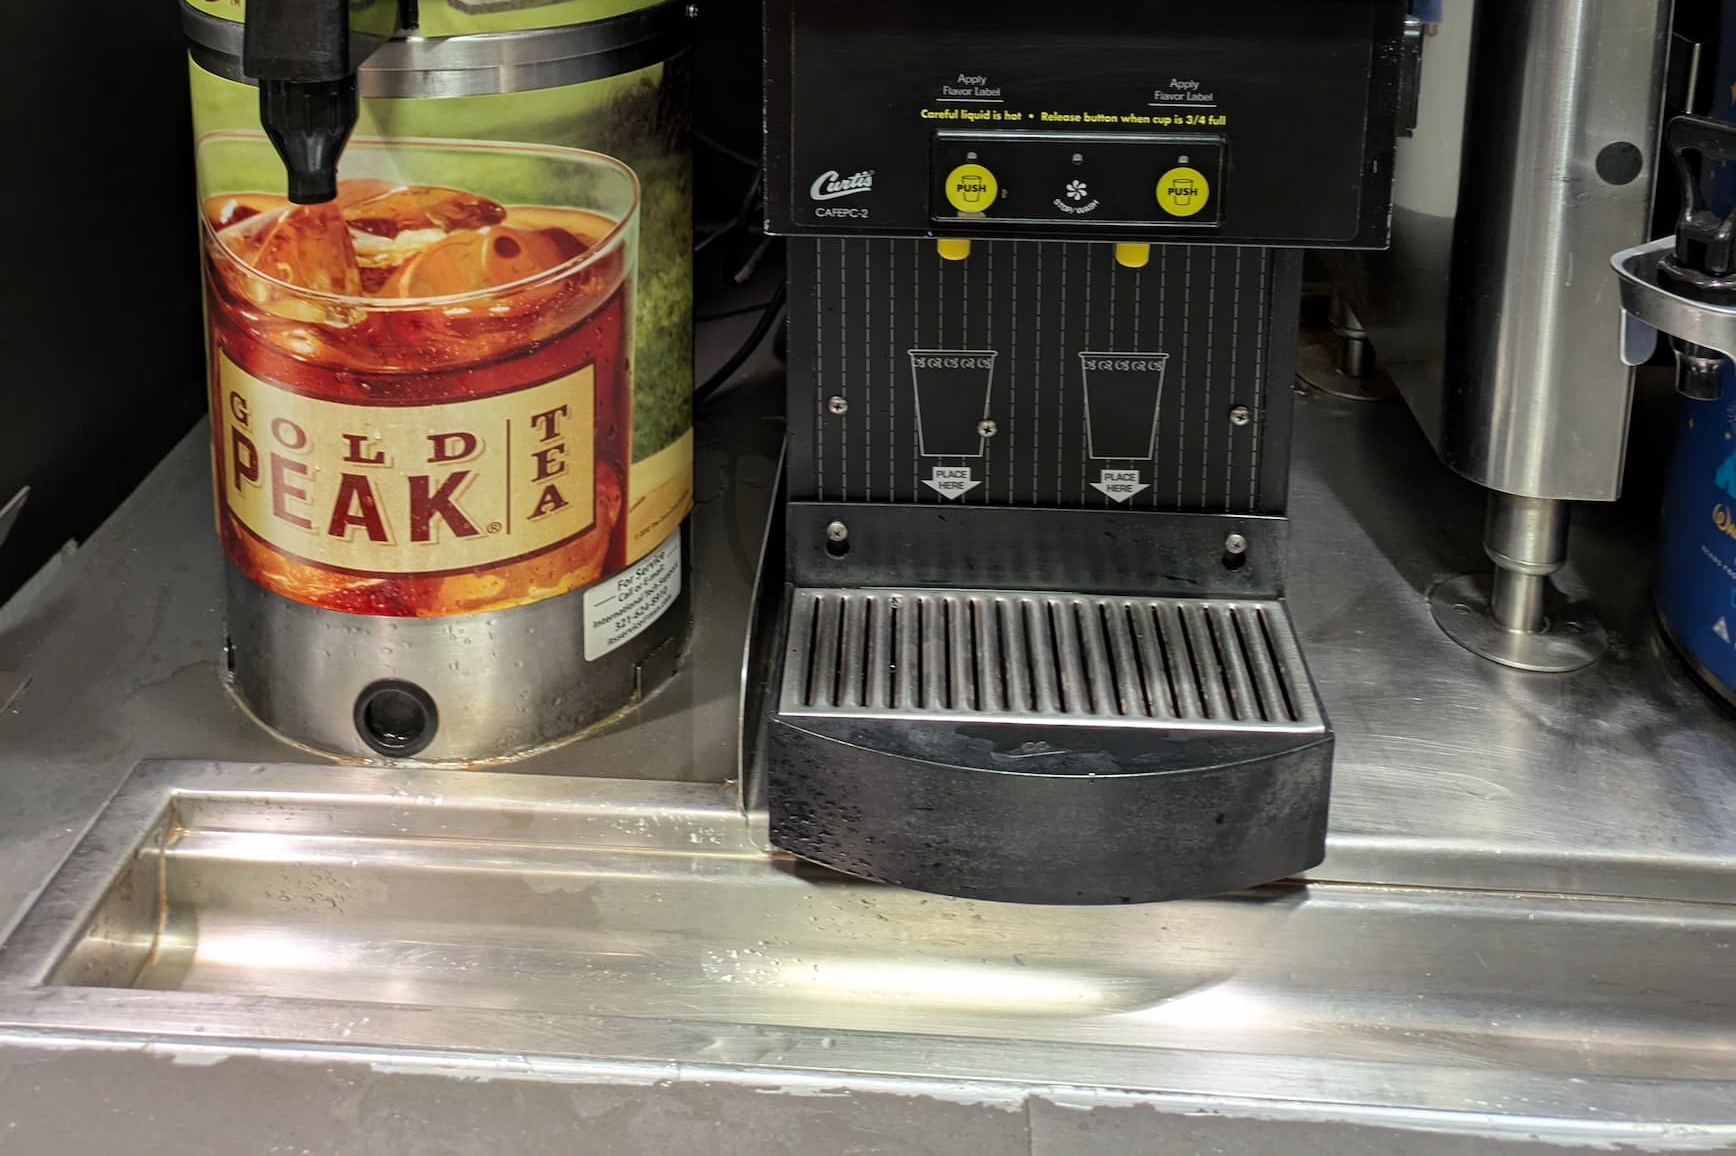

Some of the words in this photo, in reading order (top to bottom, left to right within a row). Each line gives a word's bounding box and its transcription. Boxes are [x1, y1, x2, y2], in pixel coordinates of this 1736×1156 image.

[957, 73, 987, 86] Apply
[1169, 78, 1200, 91] Apply
[943, 86, 972, 96] Flavor
[974, 87, 1001, 97] Label
[1154, 90, 1184, 101] Flavor
[1186, 92, 1214, 102] Label
[920, 109, 958, 120] Careful
[960, 109, 991, 122] liquid
[992, 111, 1002, 120] is
[1004, 110, 1022, 121] hot
[1040, 112, 1081, 122] Release
[1083, 112, 1118, 123] button
[1120, 113, 1150, 124] when
[1152, 116, 1172, 127] cup
[1174, 114, 1183, 125] is
[1185, 115, 1206, 126] 3/4
[1208, 115, 1227, 126] full
[810, 170, 873, 200] Curtis
[956, 184, 987, 192] PUSH
[1168, 188, 1198, 196] PUSH
[1053, 198, 1100, 214] STOP/WASH
[815, 207, 869, 218] CAFEPC-2
[229, 390, 478, 465] GOLD
[527, 404, 569, 520] TEA
[936, 469, 967, 479] PLACE
[1104, 473, 1137, 482] PLACE
[938, 480, 965, 490] HERE
[1107, 484, 1133, 493] HERE
